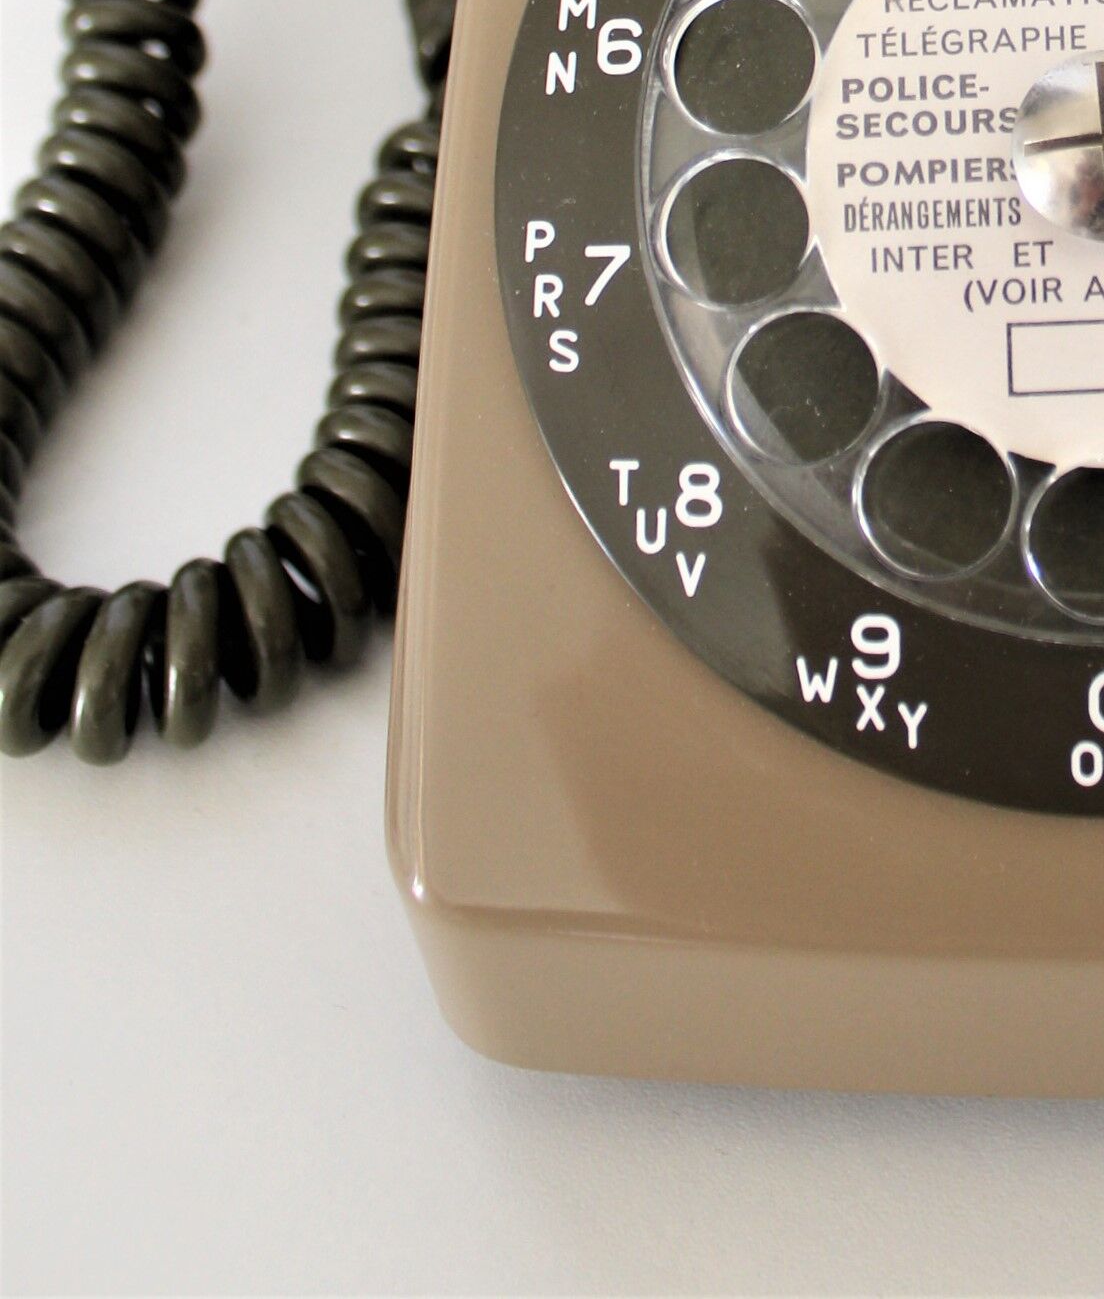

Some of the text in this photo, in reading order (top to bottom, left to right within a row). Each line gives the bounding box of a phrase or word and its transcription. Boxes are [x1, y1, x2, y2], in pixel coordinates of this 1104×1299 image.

[596, 17, 643, 76] 6
[856, 24, 1088, 60] TÉLÉGRAPHE
[841, 73, 991, 105] POLICE-
[835, 106, 1018, 141] SECOURS
[836, 157, 1017, 189] POMPIER
[843, 196, 1023, 233] DÉRANGEMENTS
[870, 243, 974, 273] INTER
[1013, 239, 1054, 269] ET
[584, 244, 631, 307] 7
[963, 276, 1063, 313] (VOIR
[674, 462, 724, 528] 8
[850, 614, 901, 680] 9
